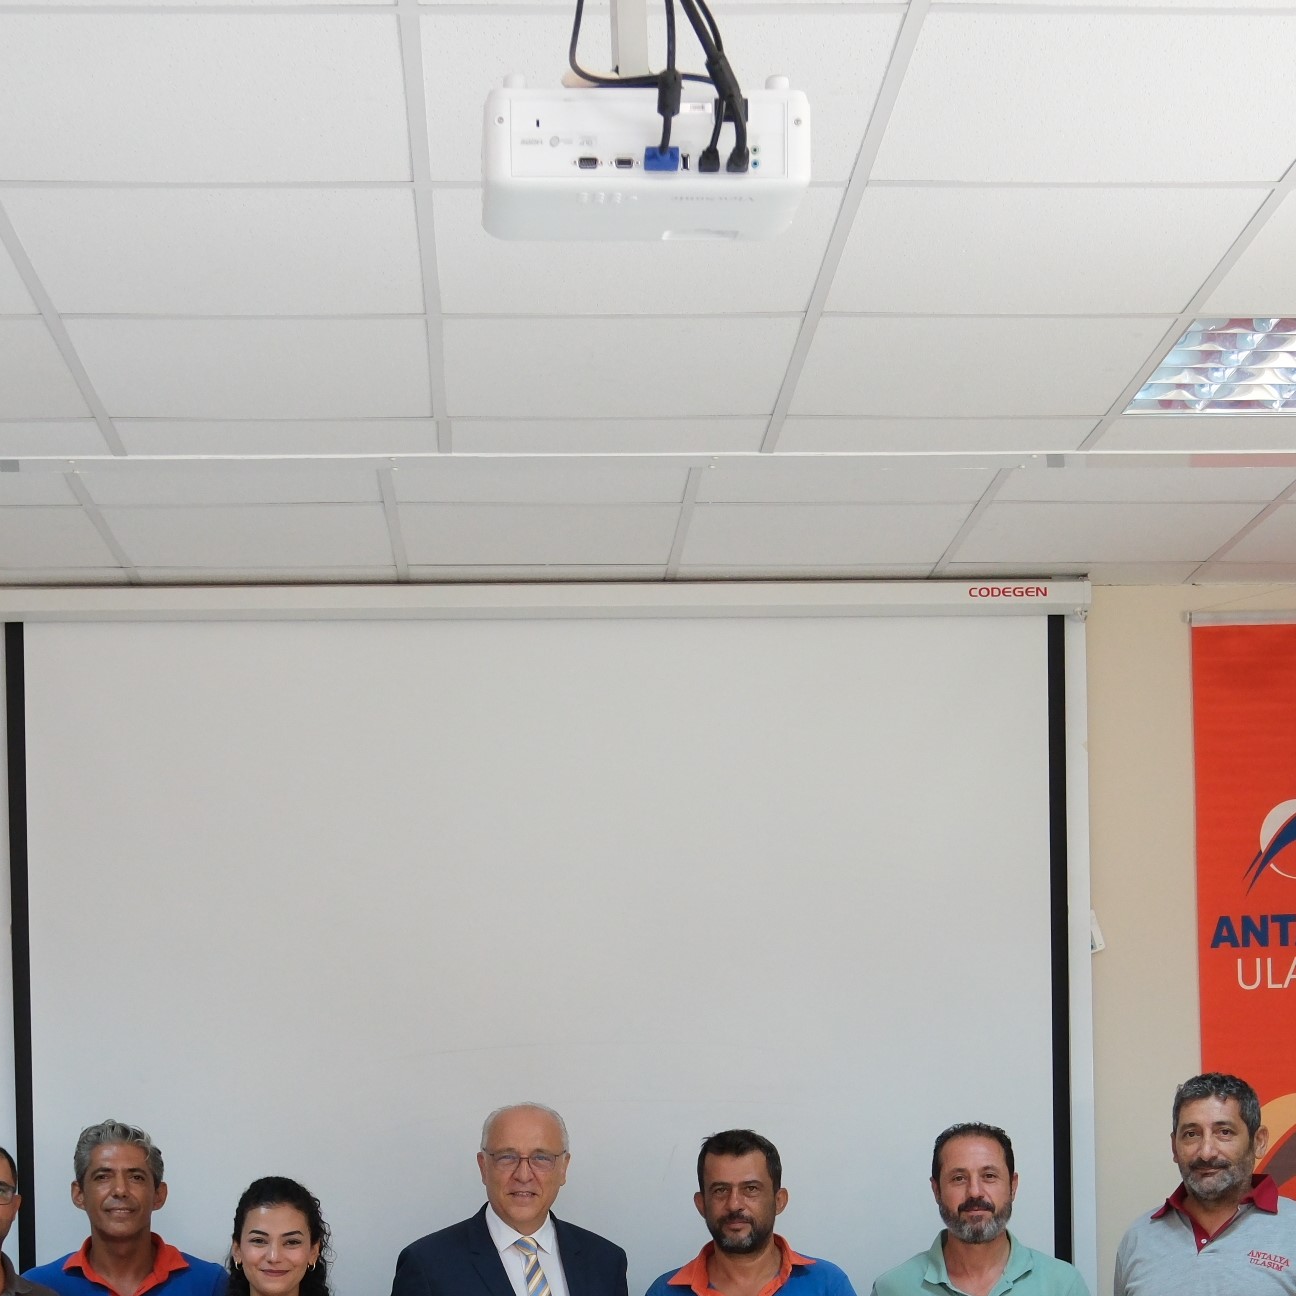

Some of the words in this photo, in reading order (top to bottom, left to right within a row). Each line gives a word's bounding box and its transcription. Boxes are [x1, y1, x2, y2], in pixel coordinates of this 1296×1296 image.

[968, 586, 1048, 598] CODEGEN
[1247, 1249, 1290, 1267] ANTALYA
[1249, 1257, 1284, 1272] ULAŞIM
